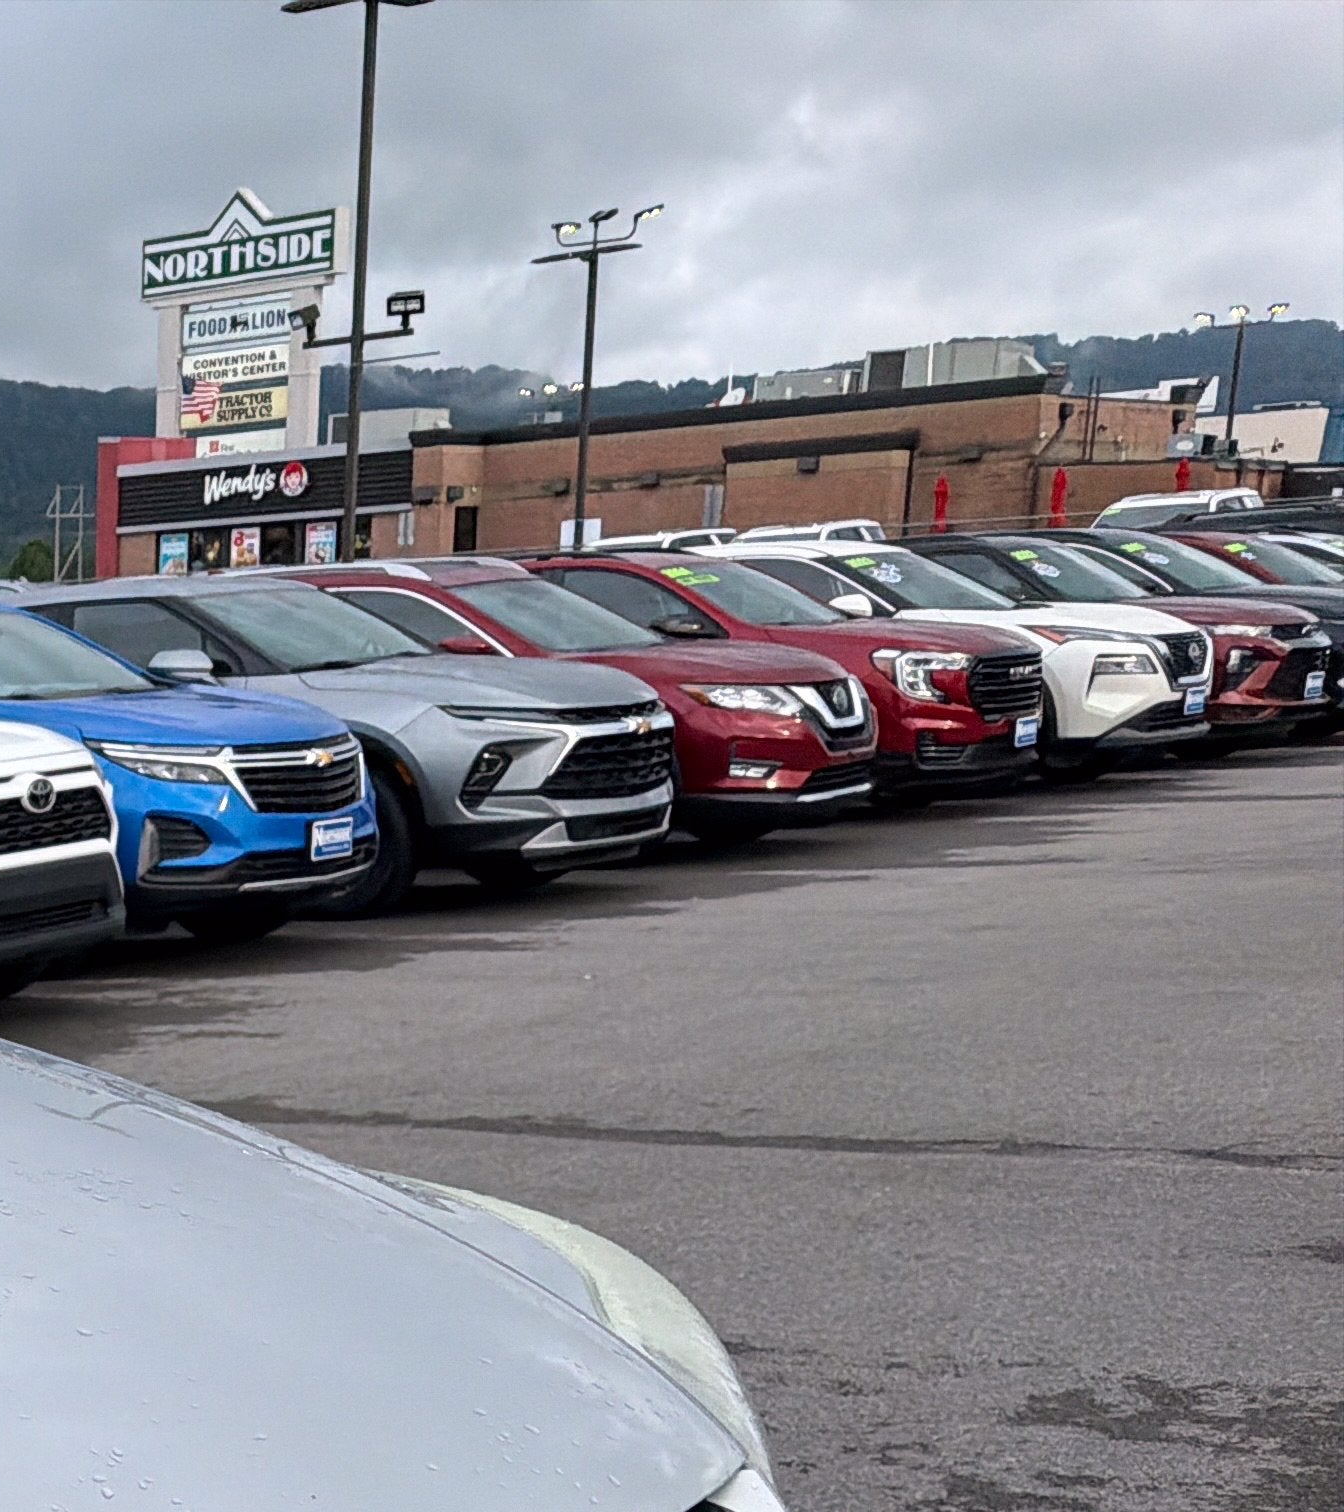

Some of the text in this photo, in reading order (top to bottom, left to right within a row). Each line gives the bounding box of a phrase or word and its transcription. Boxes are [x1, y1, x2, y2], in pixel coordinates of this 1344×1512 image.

[143, 228, 332, 286] NORTHSIDE
[188, 308, 287, 339] FOOD LION
[193, 349, 278, 370] CONVENTION &
[183, 361, 287, 382] ISITOR'S CENTER
[218, 390, 273, 410] TRACTOR
[217, 406, 257, 423] SUPPLY
[203, 463, 277, 506] Wendy's
